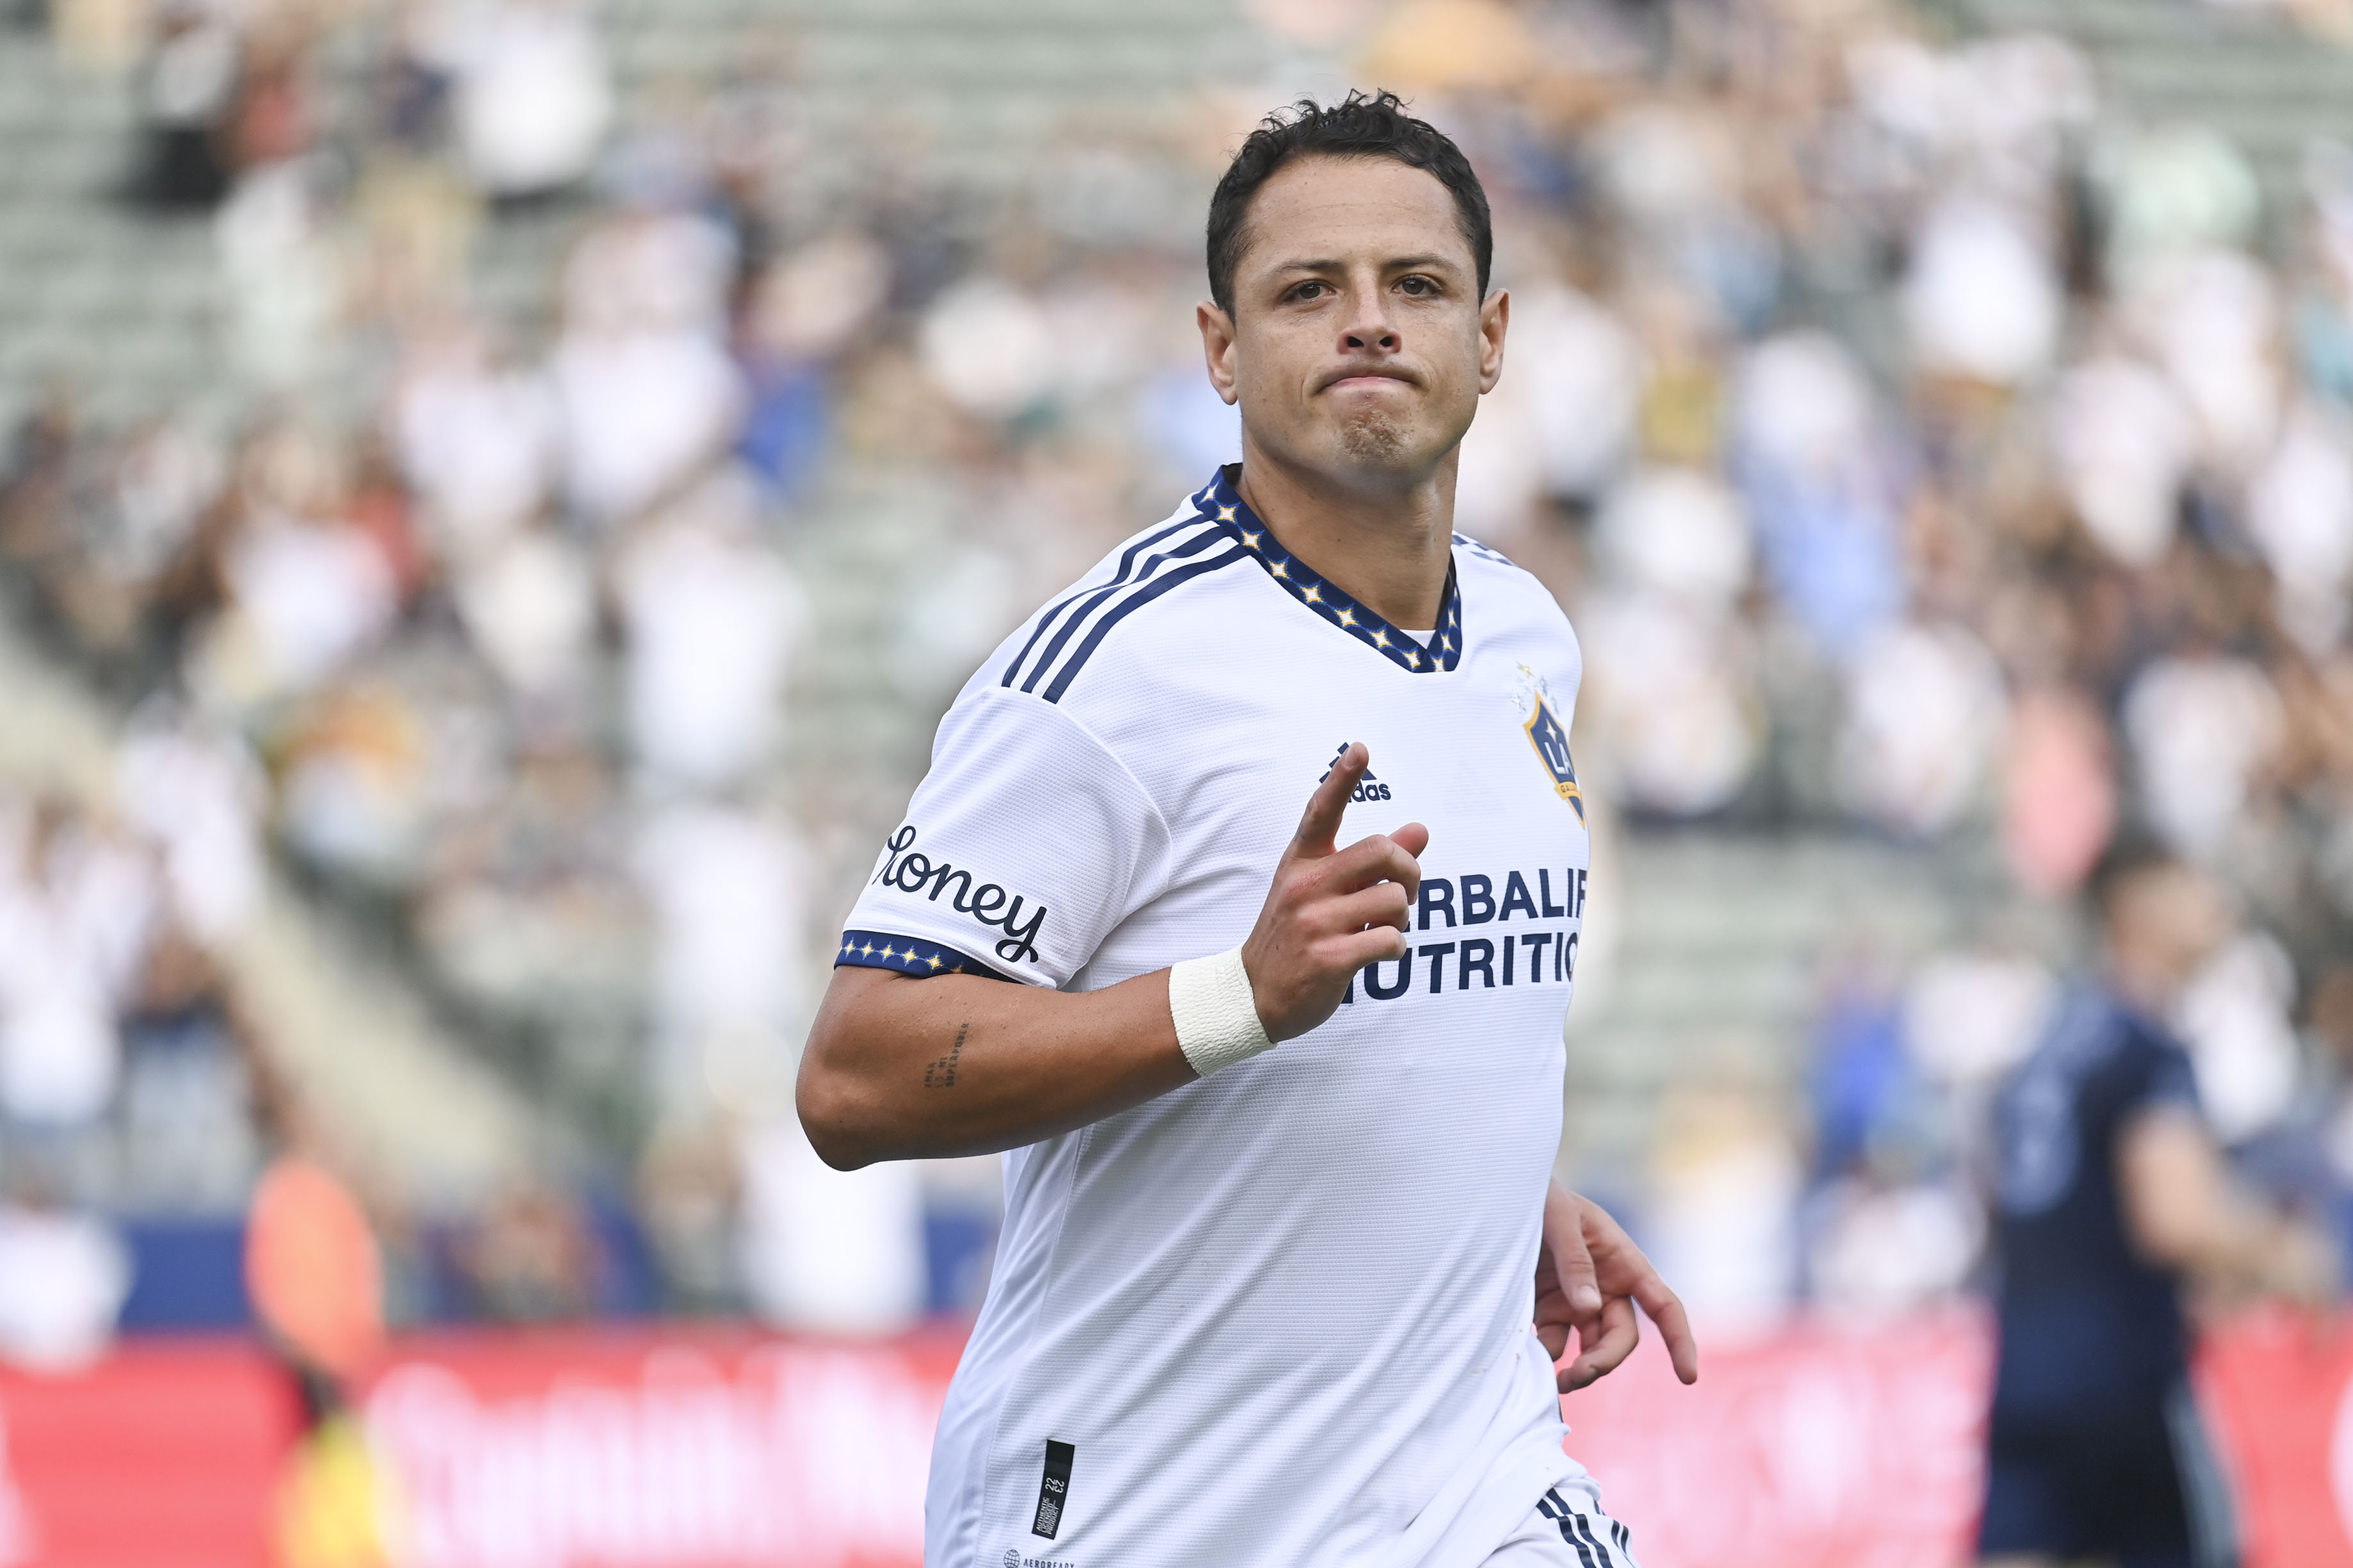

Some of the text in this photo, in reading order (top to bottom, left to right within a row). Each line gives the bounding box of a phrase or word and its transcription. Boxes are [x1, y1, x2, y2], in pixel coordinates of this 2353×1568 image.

[1348, 780, 1392, 803] das
[1402, 868, 1588, 933] RBALIF
[1045, 1477, 1055, 1491] 22
[1036, 1496, 1050, 1532] AUTHENTIC
[1041, 1503, 1054, 1533] LICENSED
[1046, 1507, 1059, 1535] PRODUCT
